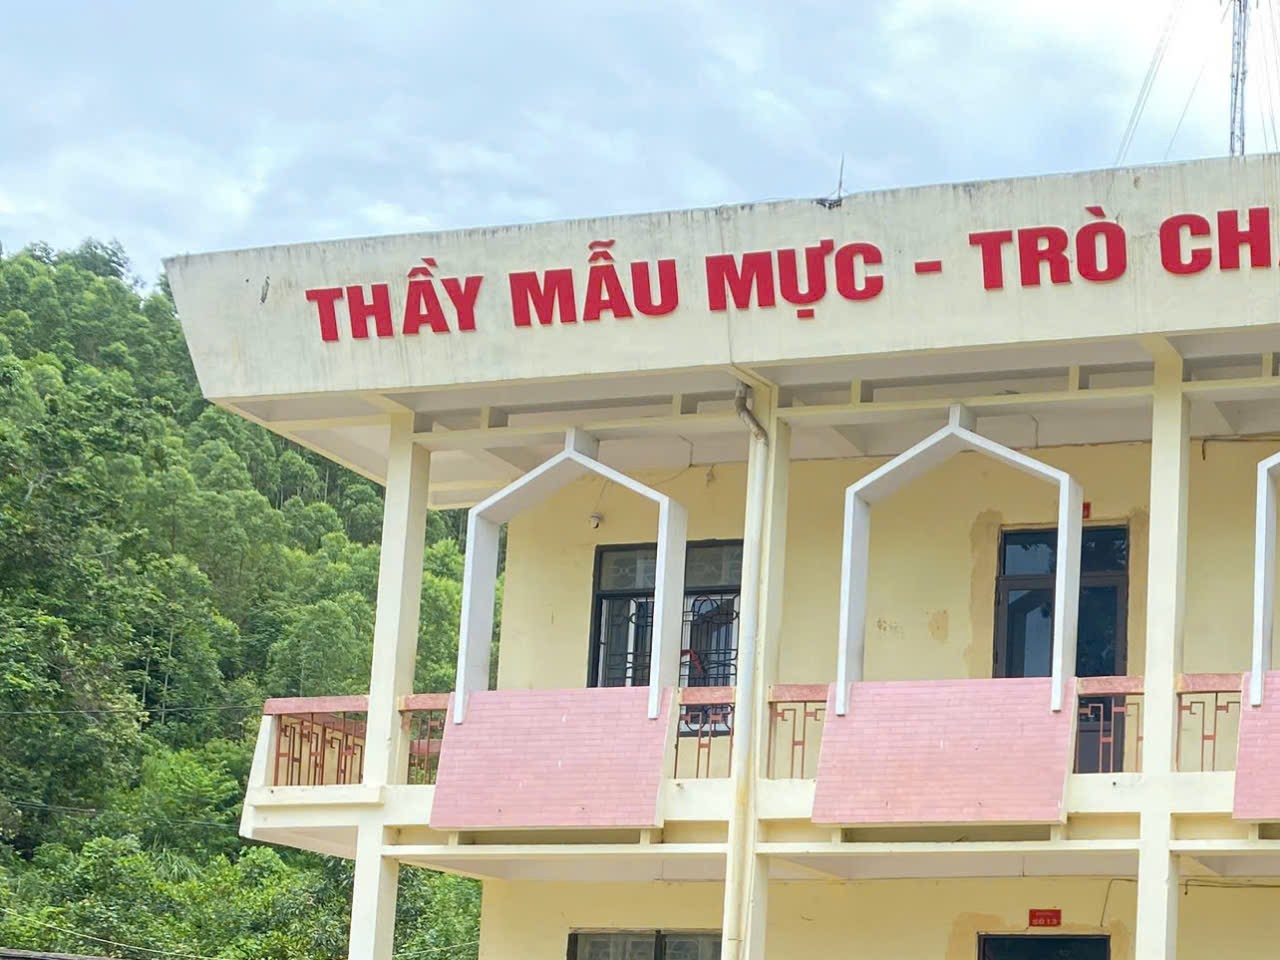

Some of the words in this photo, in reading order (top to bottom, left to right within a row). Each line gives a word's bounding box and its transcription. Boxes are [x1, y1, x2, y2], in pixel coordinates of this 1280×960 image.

[306, 257, 483, 342] THẦY
[509, 240, 680, 327] MẪU
[705, 239, 884, 319] MỰC
[914, 260, 943, 274] -
[968, 206, 1127, 290] TRÒ
